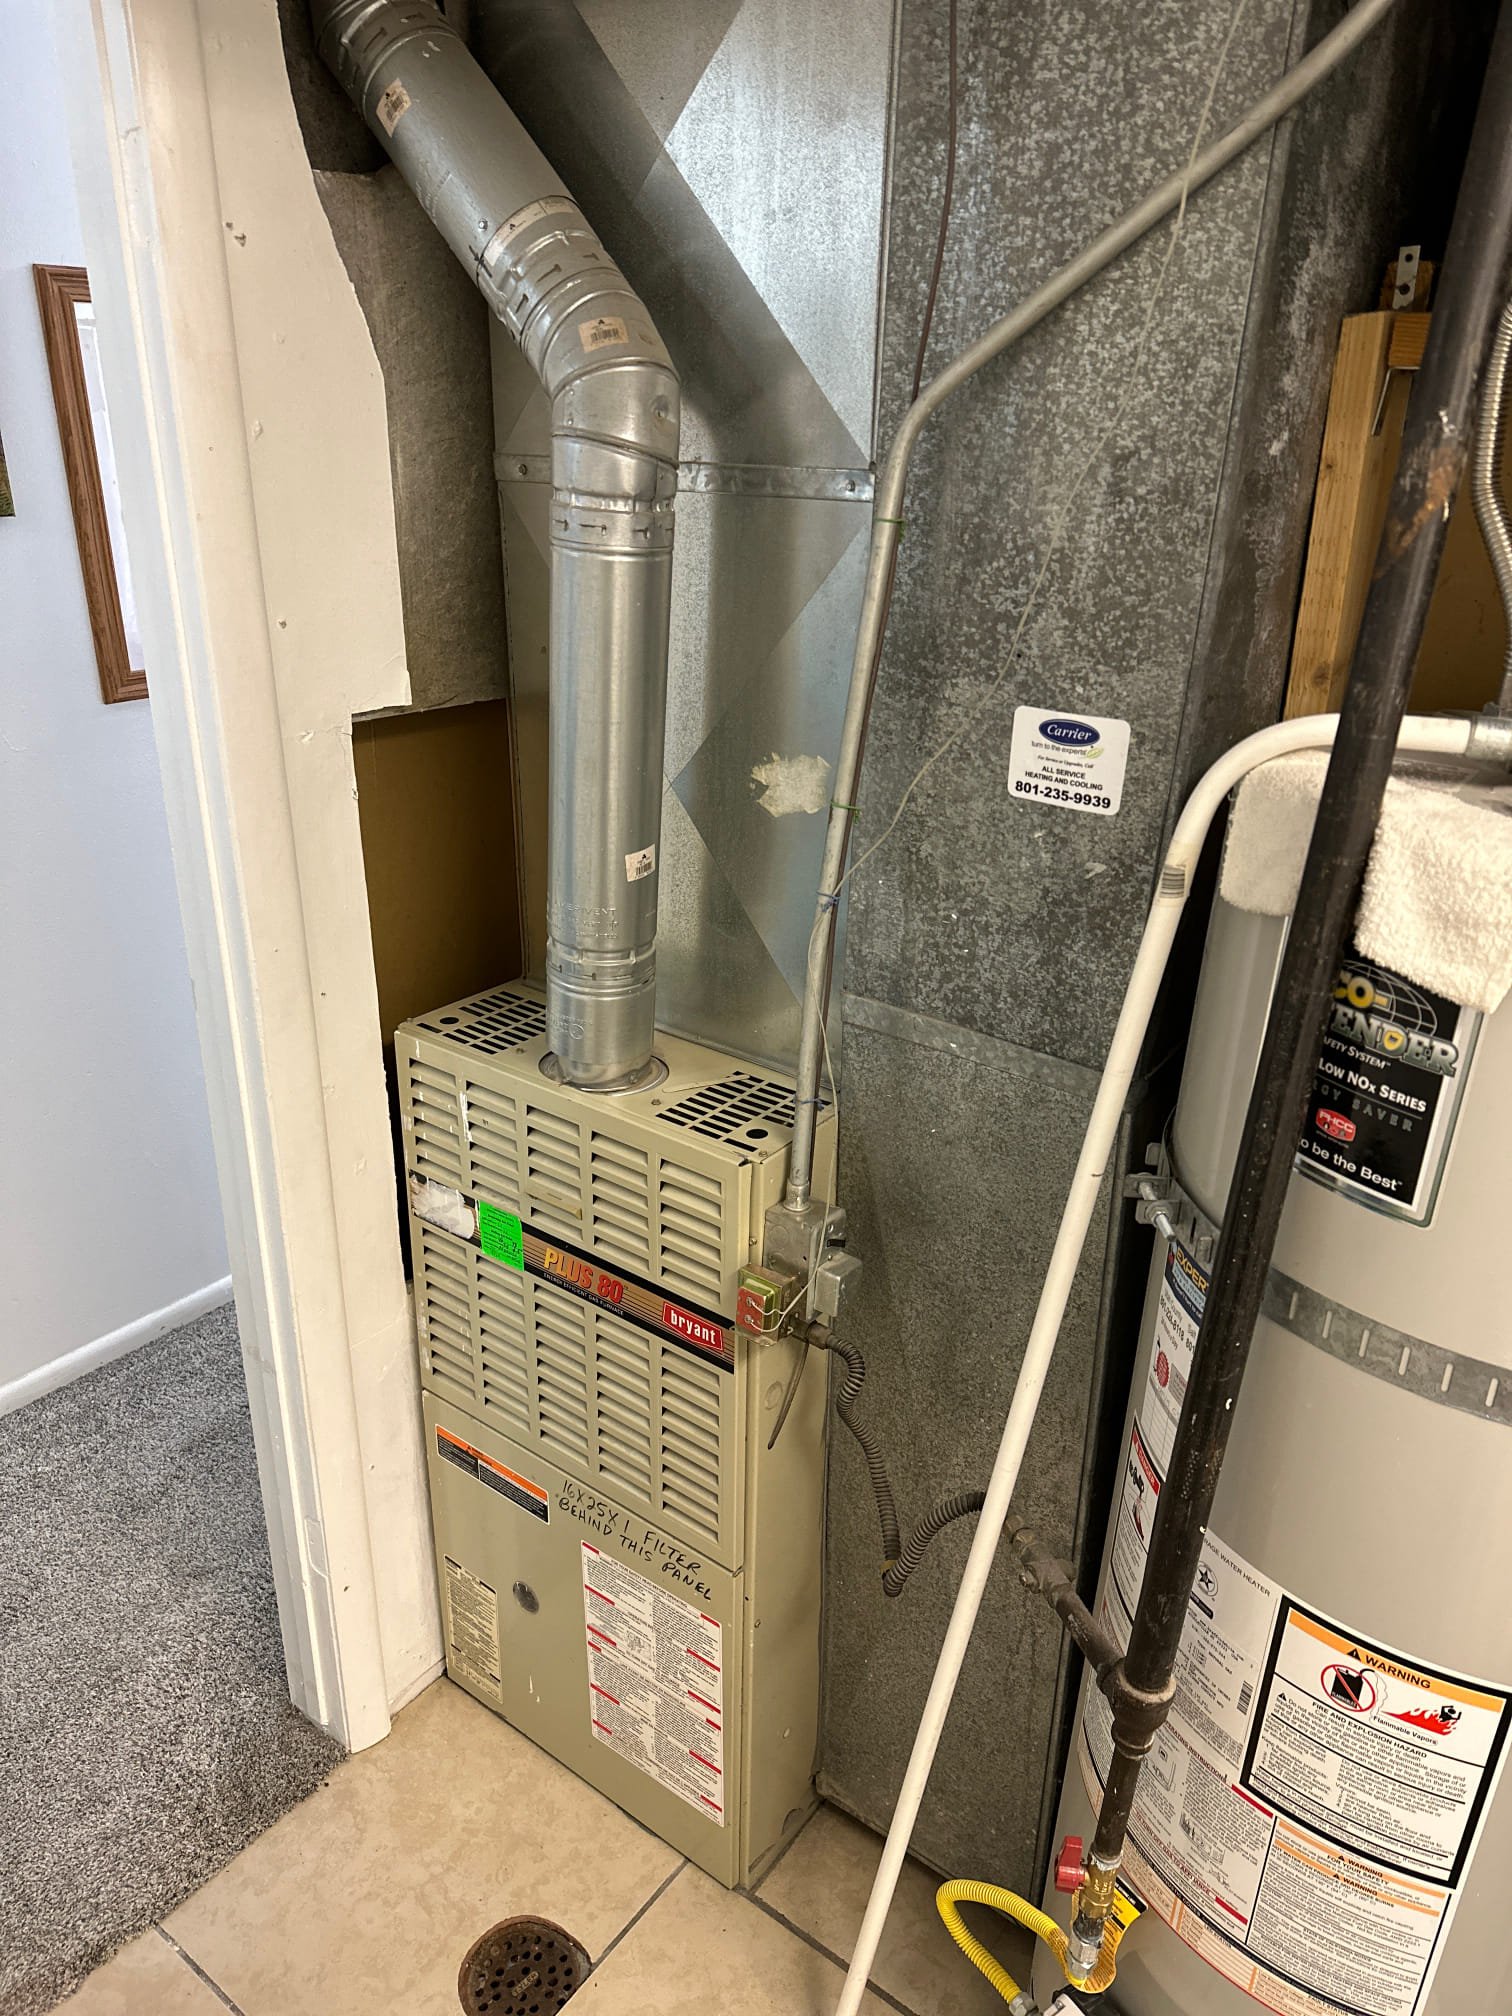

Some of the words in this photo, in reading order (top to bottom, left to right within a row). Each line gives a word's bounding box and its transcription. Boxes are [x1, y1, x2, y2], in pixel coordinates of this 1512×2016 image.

[1047, 724, 1091, 740] Carrier
[1062, 747, 1087, 756] experts
[1025, 771, 1053, 781] HEATING
[1055, 777, 1068, 785] AND
[1070, 780, 1103, 790] COOLING
[1056, 768, 1085, 779] SERVICE
[1016, 781, 1111, 808] 801-235-9939
[1318, 1057, 1345, 1079] LOW
[1347, 1069, 1376, 1094] NOx
[1379, 1085, 1427, 1112] SERIES
[1318, 1110, 1354, 1133] PHCC
[1352, 1100, 1413, 1132] SAVER
[1312, 1141, 1330, 1160] be
[1333, 1152, 1357, 1173] the
[1360, 1166, 1399, 1192] Best
[544, 1248, 593, 1289] PLUS
[597, 1274, 624, 1304] 80
[1176, 1247, 1207, 1293] EXPER
[544, 1272, 563, 1286] ENERGY
[563, 1282, 587, 1297] EFFICIENT
[589, 1294, 599, 1304] GAS
[600, 1299, 624, 1316] FURNACE
[671, 1310, 716, 1345] bryant
[559, 1497, 612, 1535] BEHIND
[620, 1535, 653, 1561] THIS
[662, 1563, 711, 1601] PANEL
[644, 1531, 701, 1575] FILTER
[1220, 1553, 1241, 1576] WATER
[1243, 1572, 1270, 1597] HEATER
[1364, 1653, 1431, 1690] WARNING
[1311, 1700, 1329, 1714] FIRE
[1330, 1710, 1346, 1724] AND
[1347, 1720, 1392, 1745] EXPLOSION
[1392, 1741, 1427, 1759] HAZARD
[1372, 1714, 1410, 1736] Flammable
[1411, 1731, 1438, 1746] Vapors
[1327, 1855, 1339, 1864] FOR
[1342, 1860, 1361, 1873] YOUR
[1363, 1868, 1389, 1885] SAFETY
[1348, 1859, 1383, 1877] WARNING
[1343, 1877, 1378, 1896] WARNING
